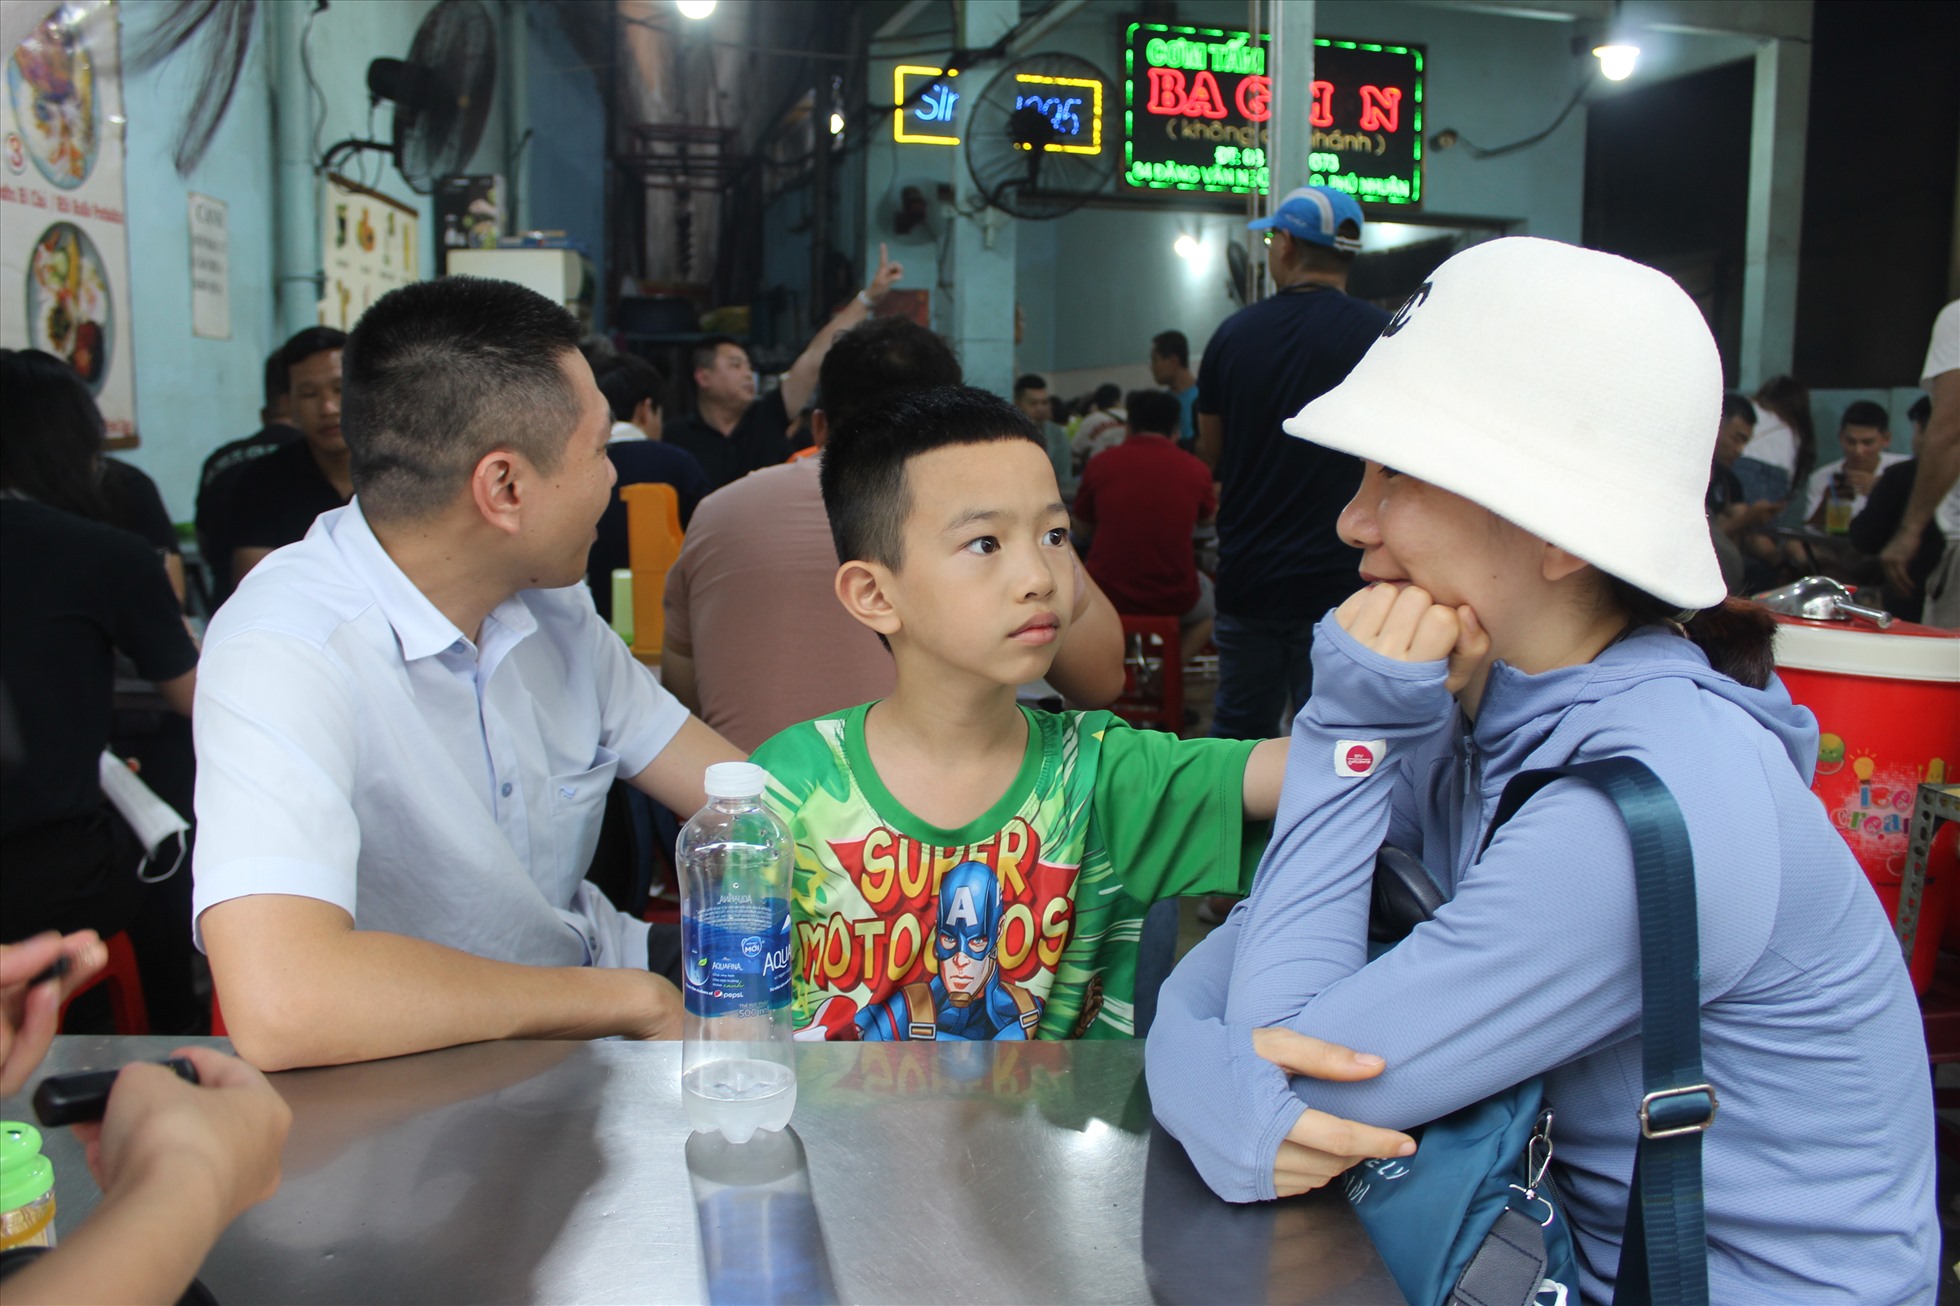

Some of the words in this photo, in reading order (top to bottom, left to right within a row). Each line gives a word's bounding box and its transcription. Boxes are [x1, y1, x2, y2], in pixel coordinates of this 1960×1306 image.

[1147, 67, 1228, 119] BA
[1831, 808, 1909, 835] crea
[799, 897, 1070, 983] MOTOOS
